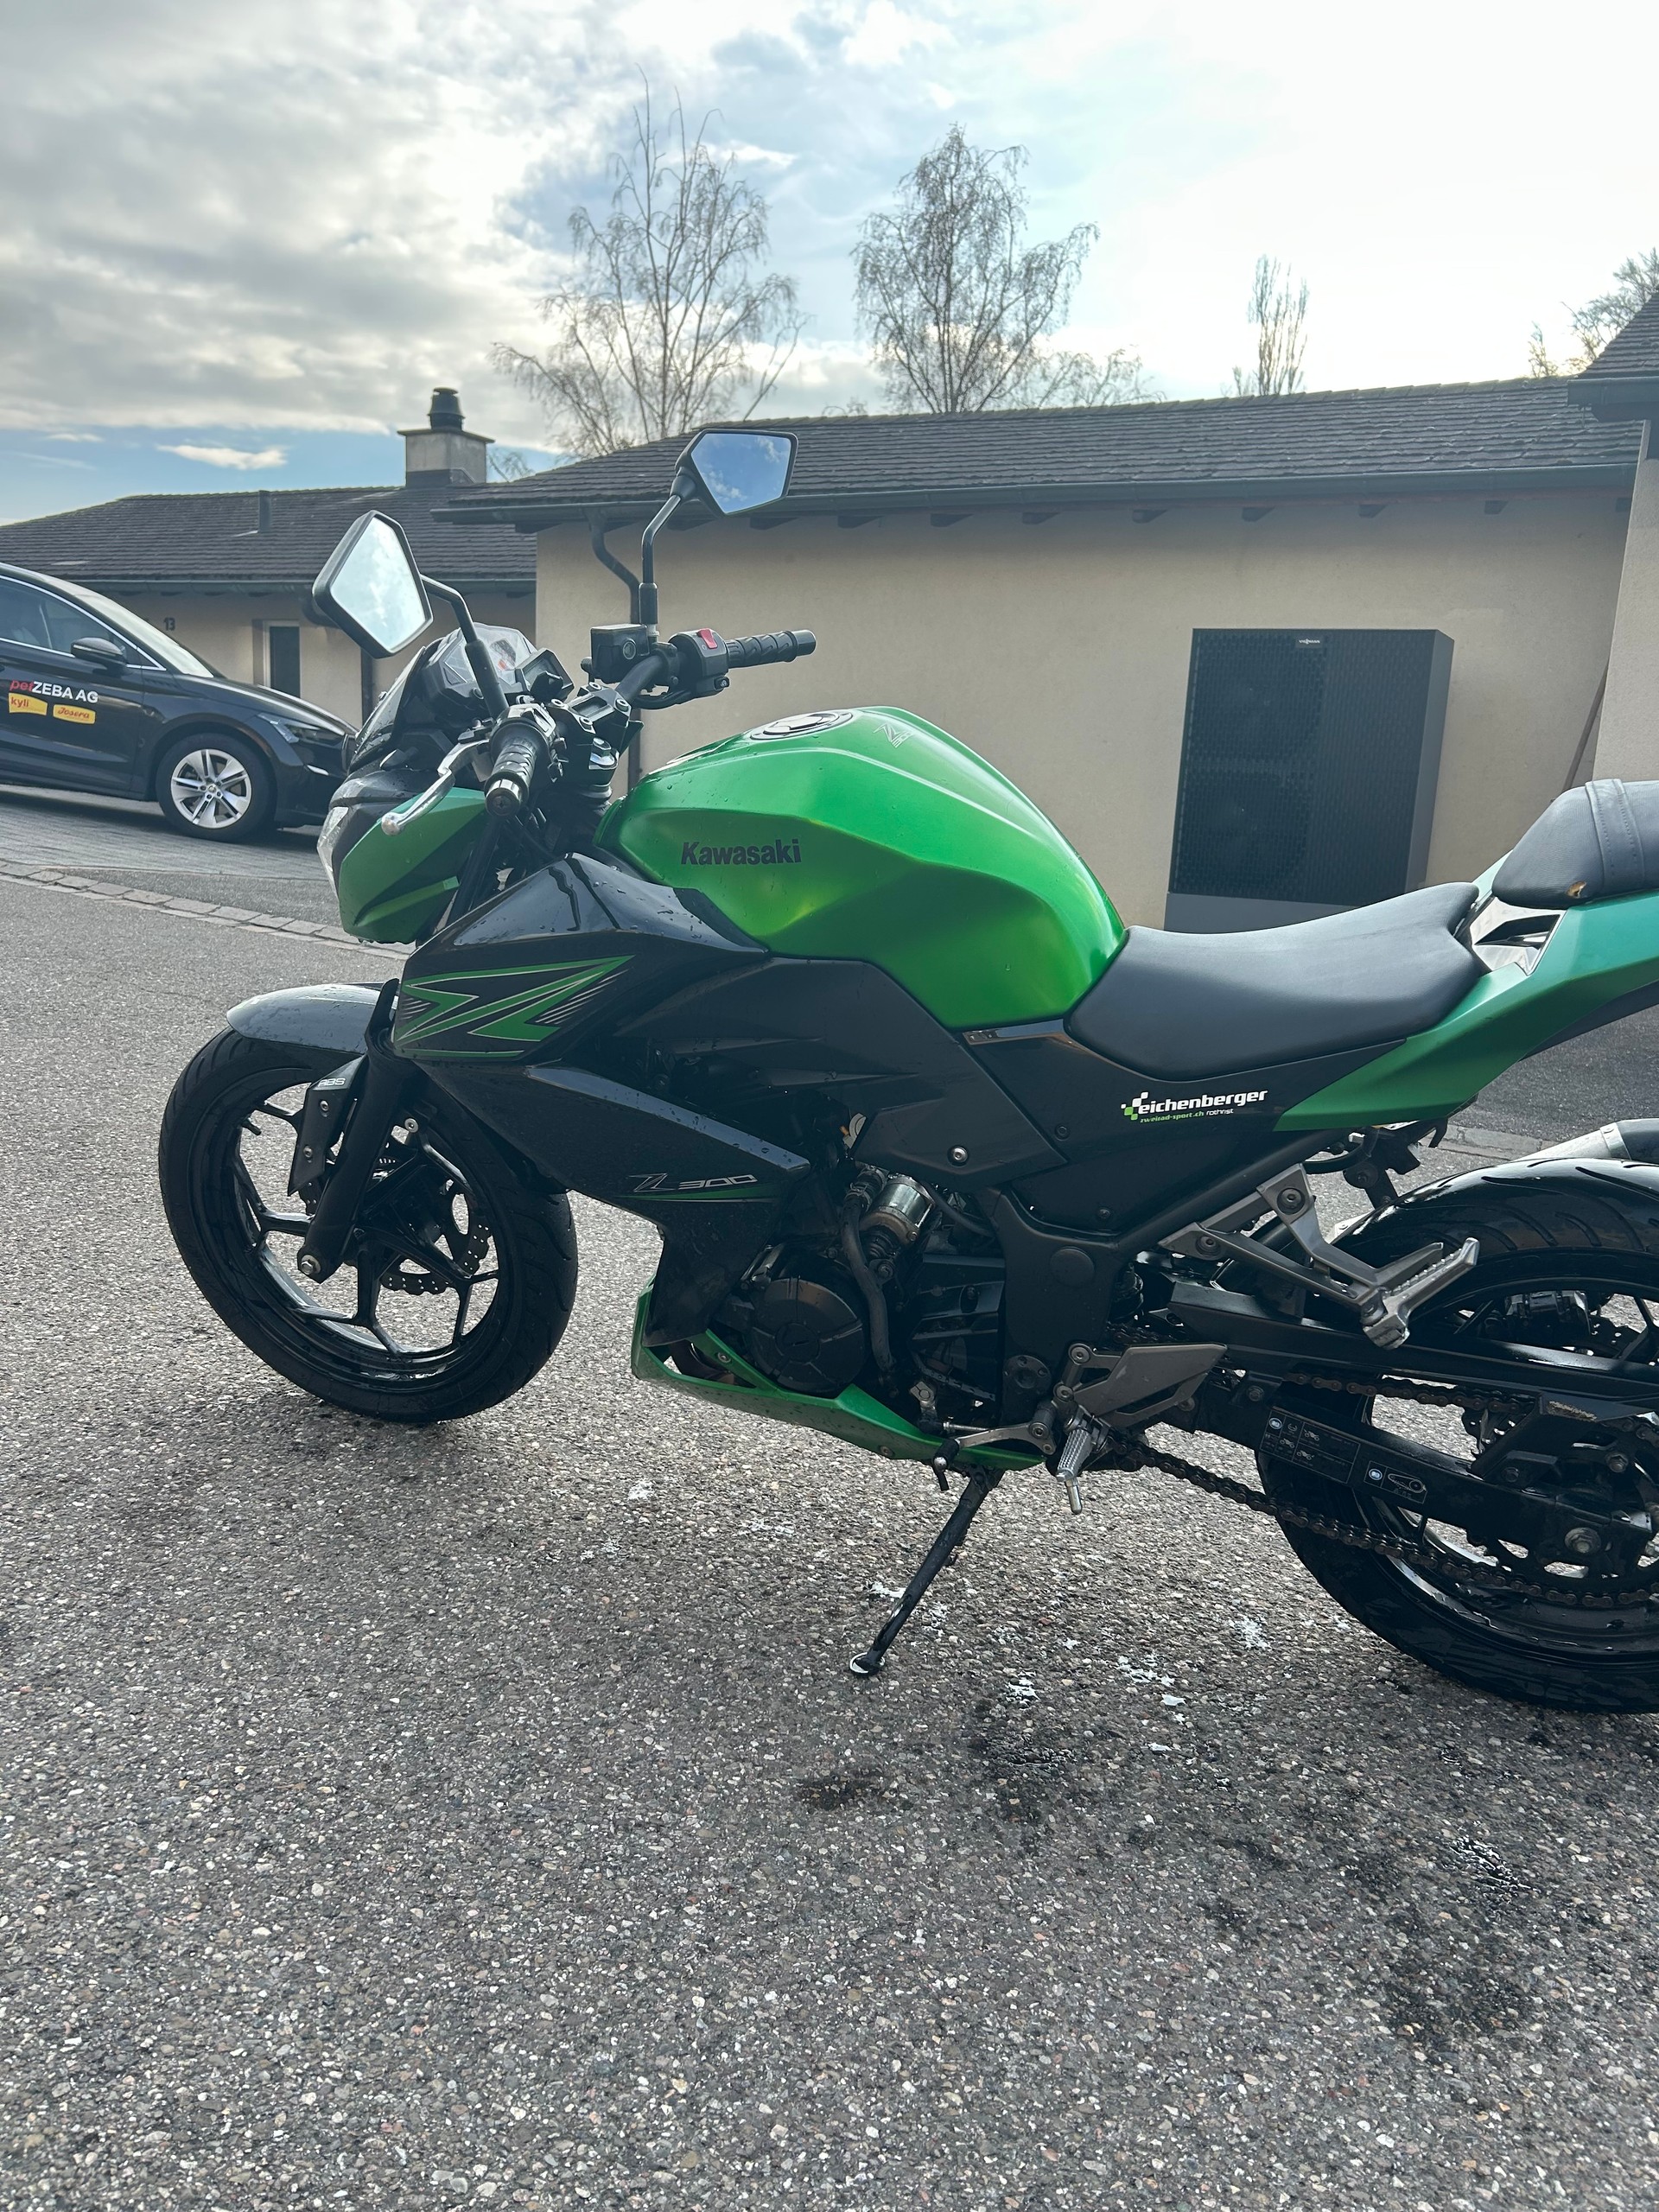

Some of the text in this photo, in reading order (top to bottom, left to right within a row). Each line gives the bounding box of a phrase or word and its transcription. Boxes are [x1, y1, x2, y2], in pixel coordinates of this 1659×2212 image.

[163, 617, 175, 631] 13
[75, 690, 99, 703] AG
[57, 707, 90, 719] Josera
[681, 838, 802, 865] Kawasaki
[317, 1077, 346, 1087] ABS
[1139, 1090, 1268, 1115] eichenberger
[1140, 1111, 1205, 1123] zweirad-sport.ch
